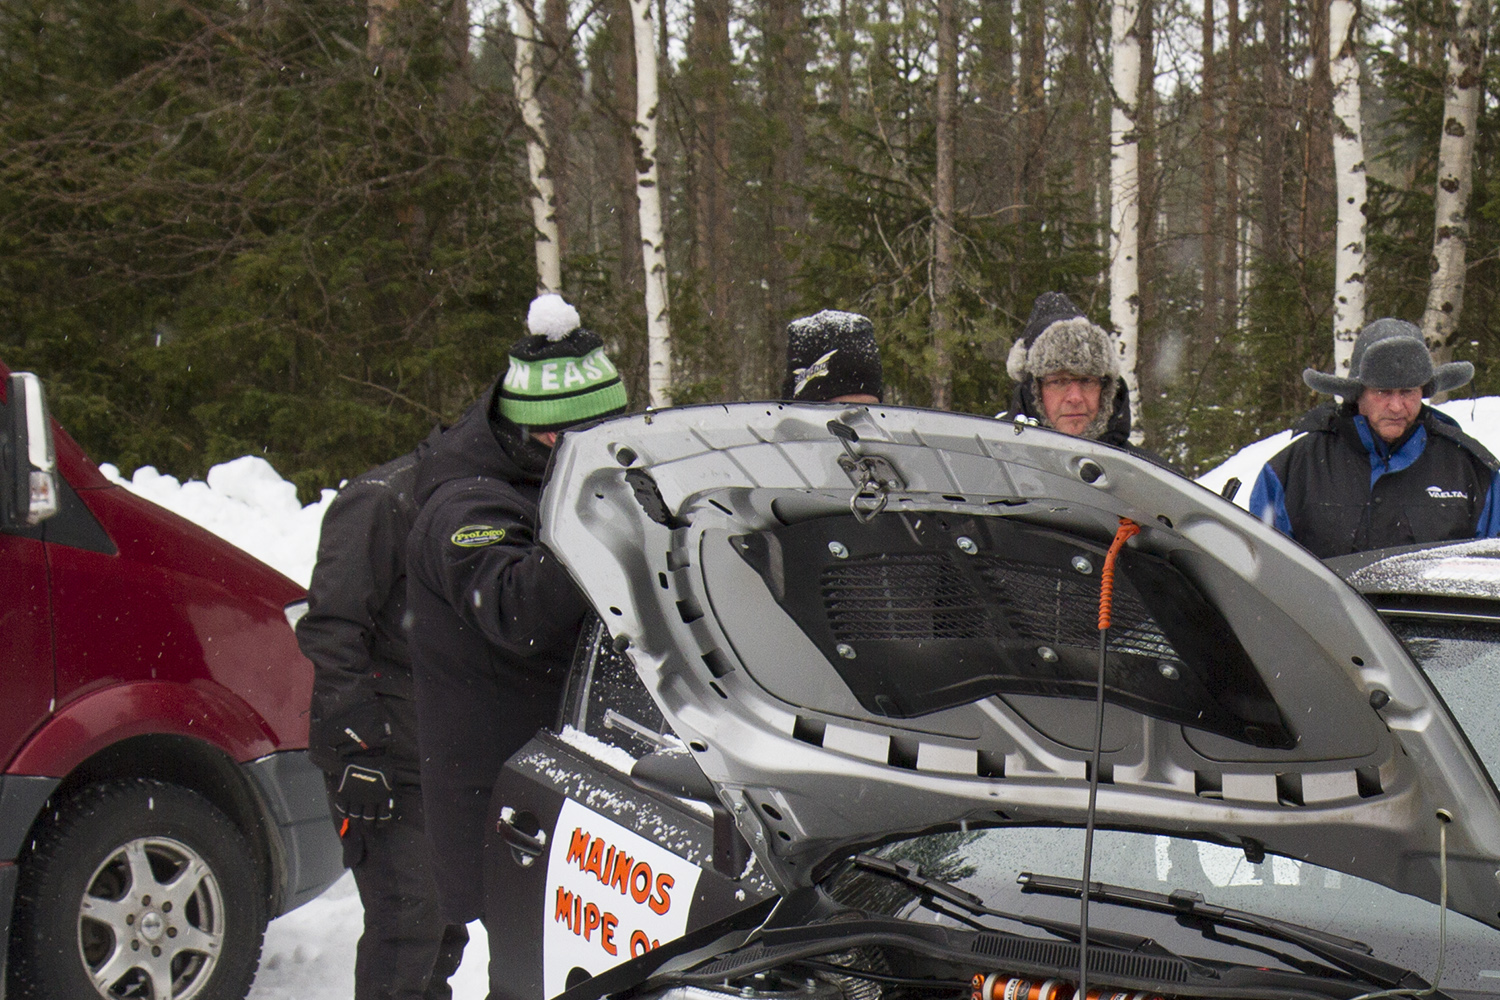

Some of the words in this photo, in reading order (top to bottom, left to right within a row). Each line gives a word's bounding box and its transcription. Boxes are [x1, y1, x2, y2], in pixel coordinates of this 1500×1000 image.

[566, 827, 675, 916] MAINOS
[555, 886, 619, 957] MIPE
[630, 930, 661, 959] O
